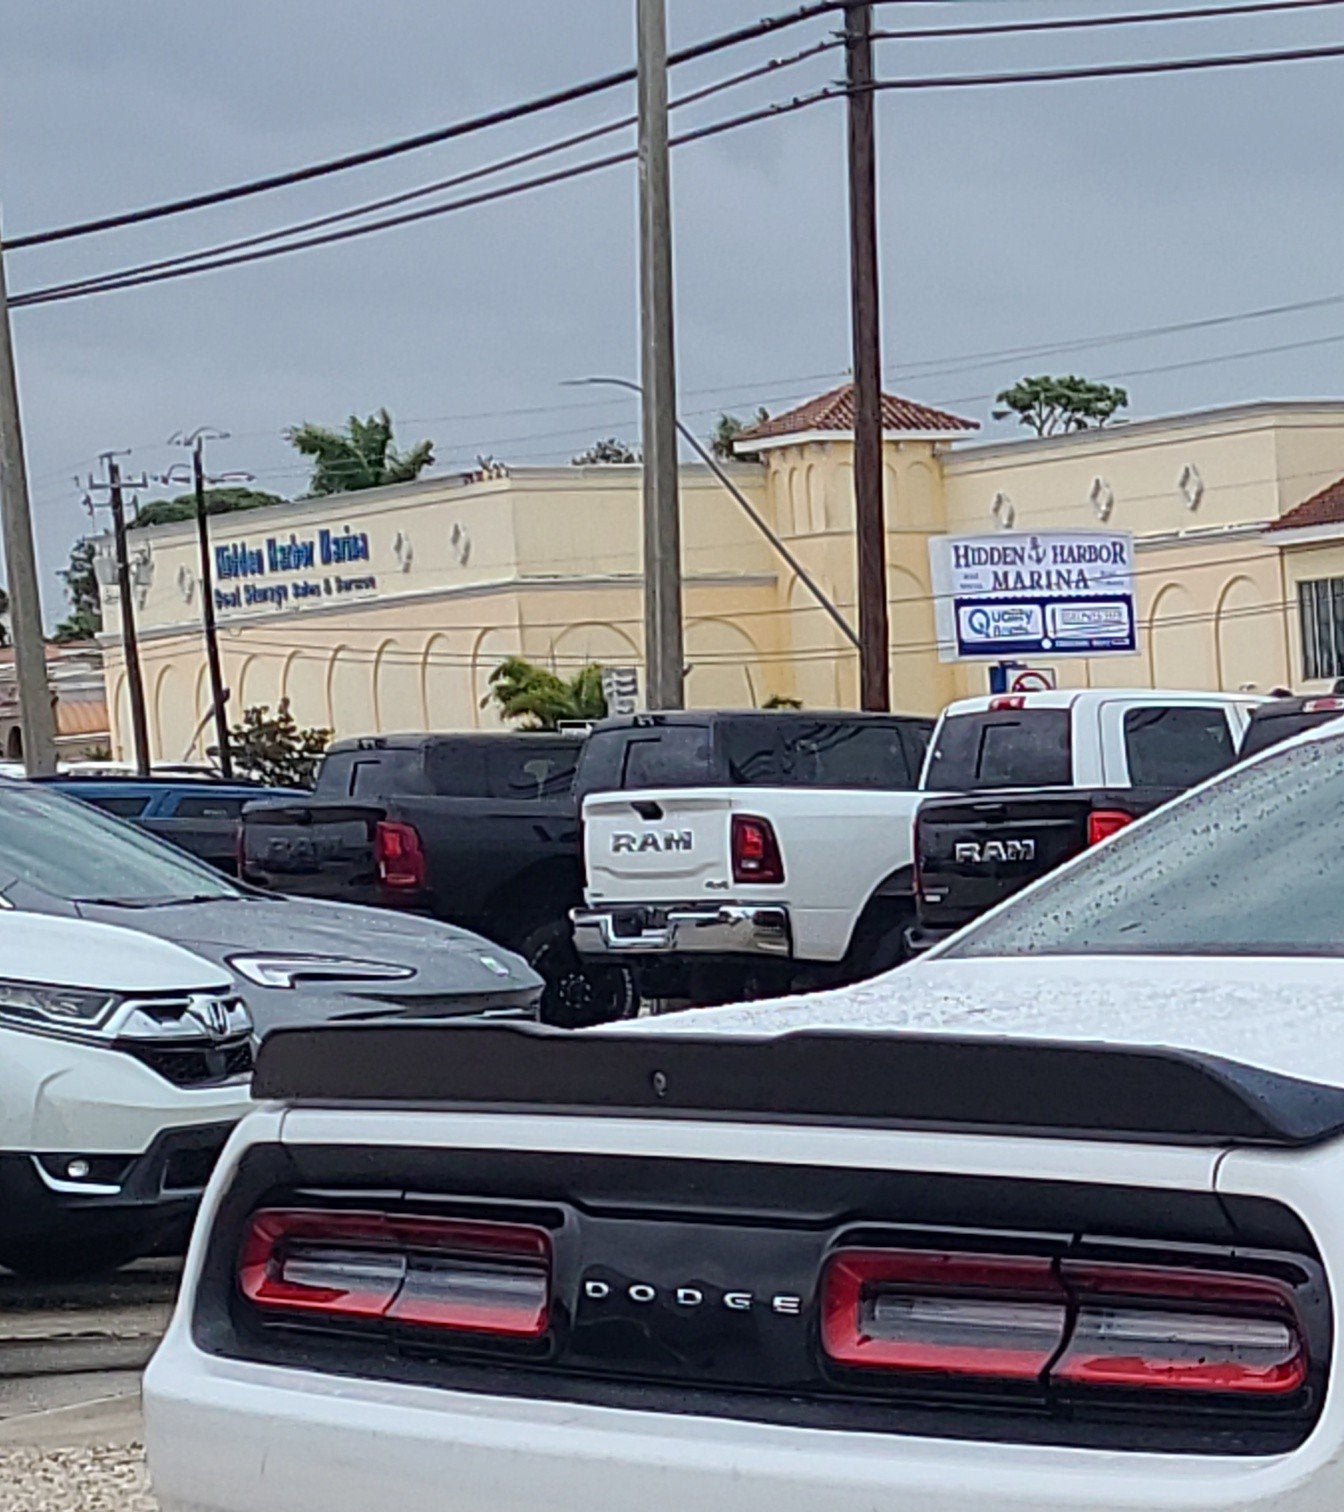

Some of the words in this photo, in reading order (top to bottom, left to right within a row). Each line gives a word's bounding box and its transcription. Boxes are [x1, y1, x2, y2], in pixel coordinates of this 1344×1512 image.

[215, 542, 265, 580] Hidden
[266, 533, 314, 572] Harbor
[319, 525, 369, 565] Marina
[953, 545, 1025, 568] HIDDEN
[1051, 541, 1126, 565] HARBOR
[991, 569, 1090, 591] MARINA
[612, 831, 692, 853] RAM
[955, 838, 1035, 862] RAM
[585, 1280, 800, 1314] DODGE
